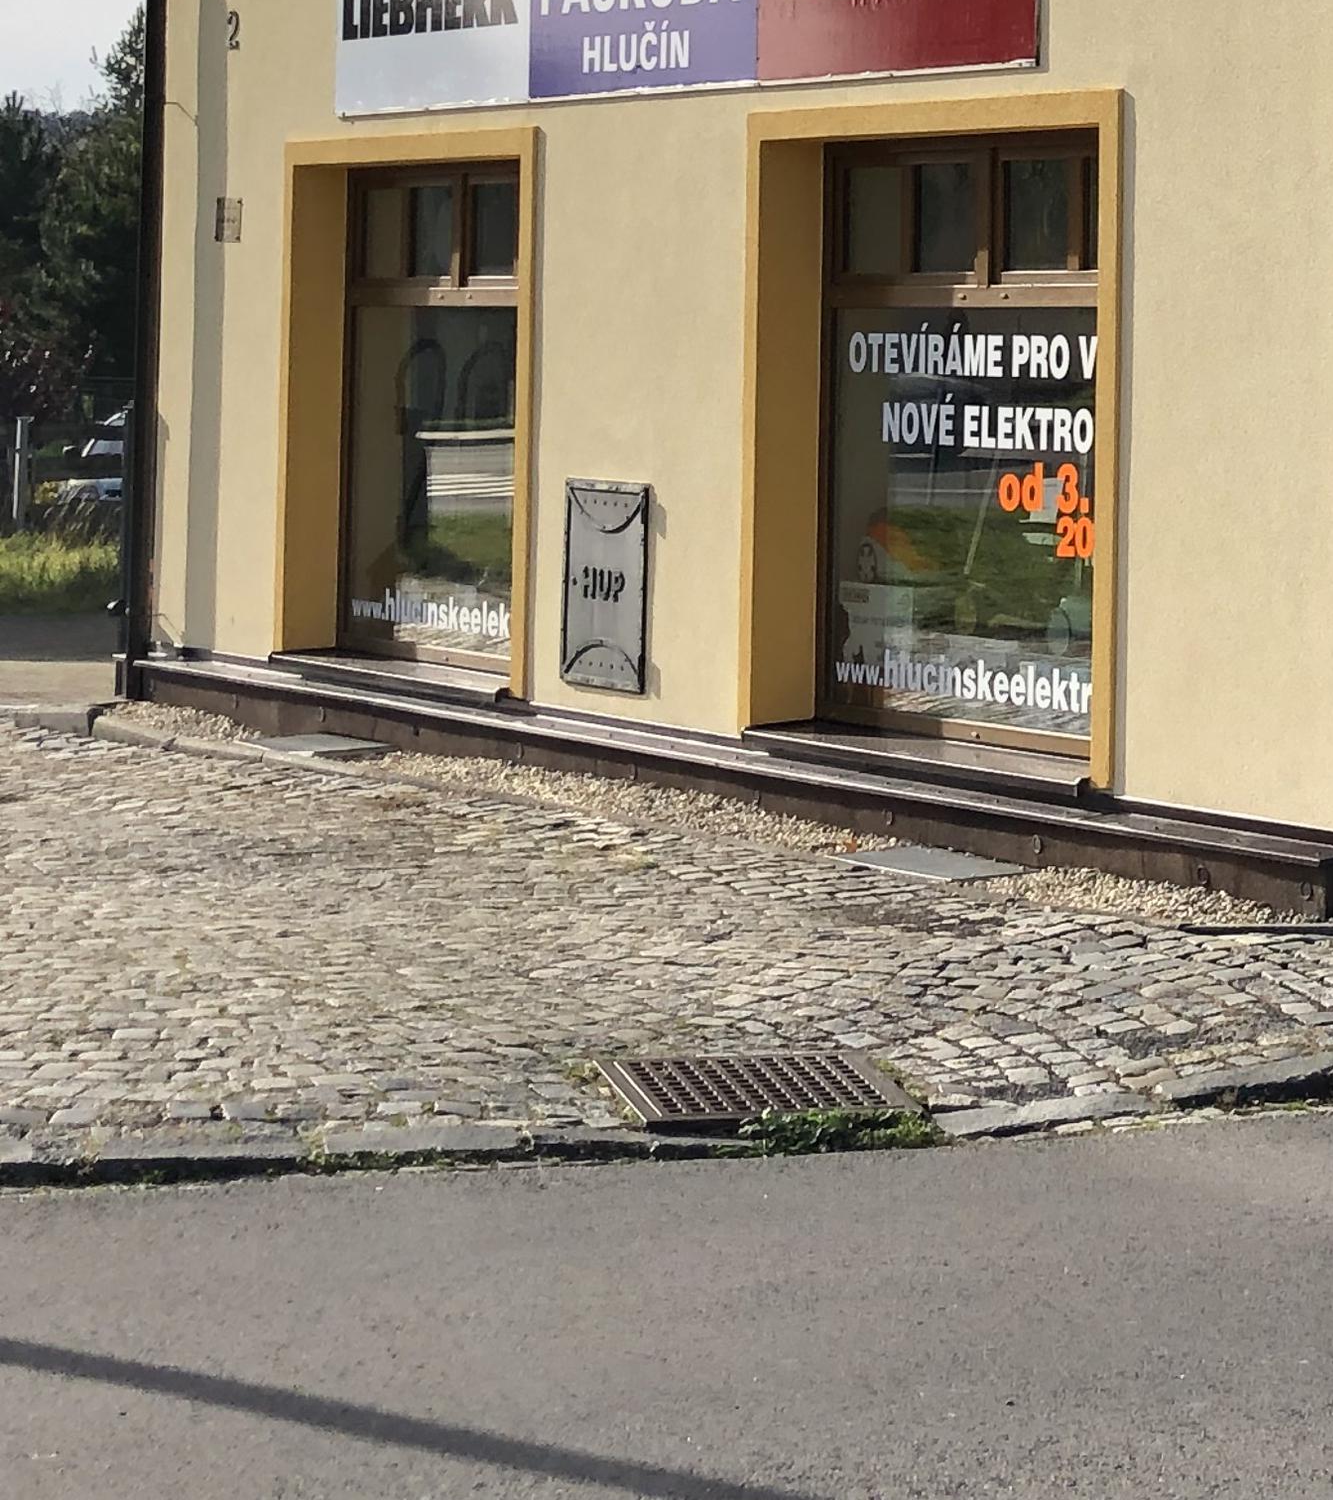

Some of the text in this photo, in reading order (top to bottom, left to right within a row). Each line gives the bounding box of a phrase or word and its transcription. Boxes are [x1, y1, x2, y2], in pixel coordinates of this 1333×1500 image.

[227, 10, 240, 51] 2
[582, 20, 690, 75] HLUČÍN
[849, 322, 1004, 378] OTEVÍRÁME
[1011, 334, 1070, 380] PRO
[882, 394, 1094, 454] NOVÉ ELEKTRO
[999, 462, 1089, 515] od 3.
